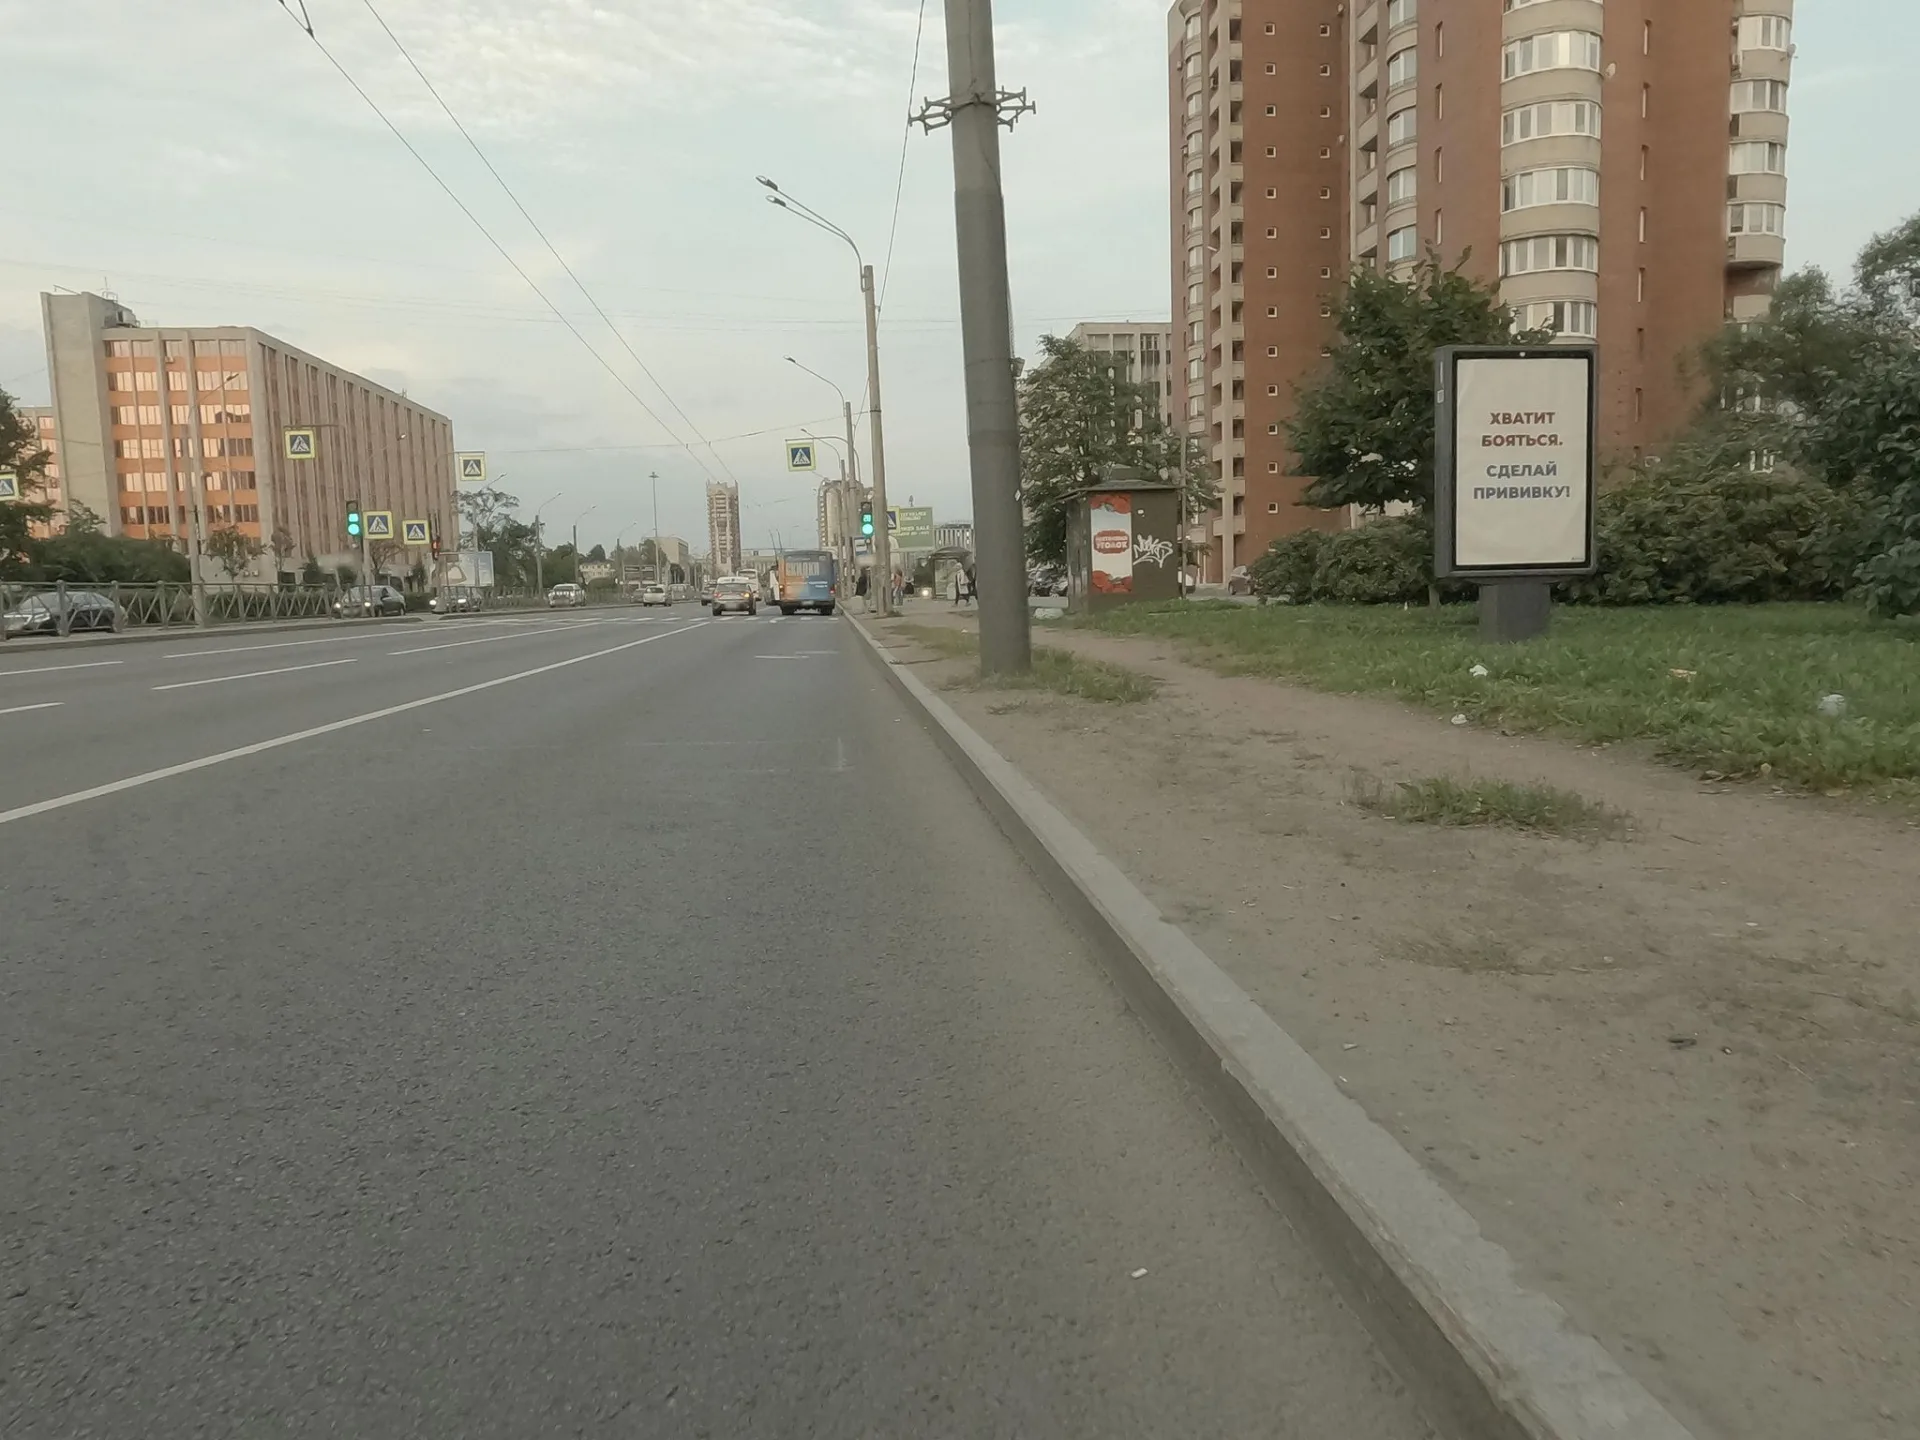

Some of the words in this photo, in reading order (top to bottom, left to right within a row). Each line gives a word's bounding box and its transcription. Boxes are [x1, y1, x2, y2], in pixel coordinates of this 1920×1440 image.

[1490, 412, 1555, 425] ХВАТИТ
[1481, 434, 1563, 447] БОЯТЬСЯ.
[1486, 461, 1557, 479] СДЕЛАЙ
[1473, 486, 1570, 499] ПРИВИВКУ!
